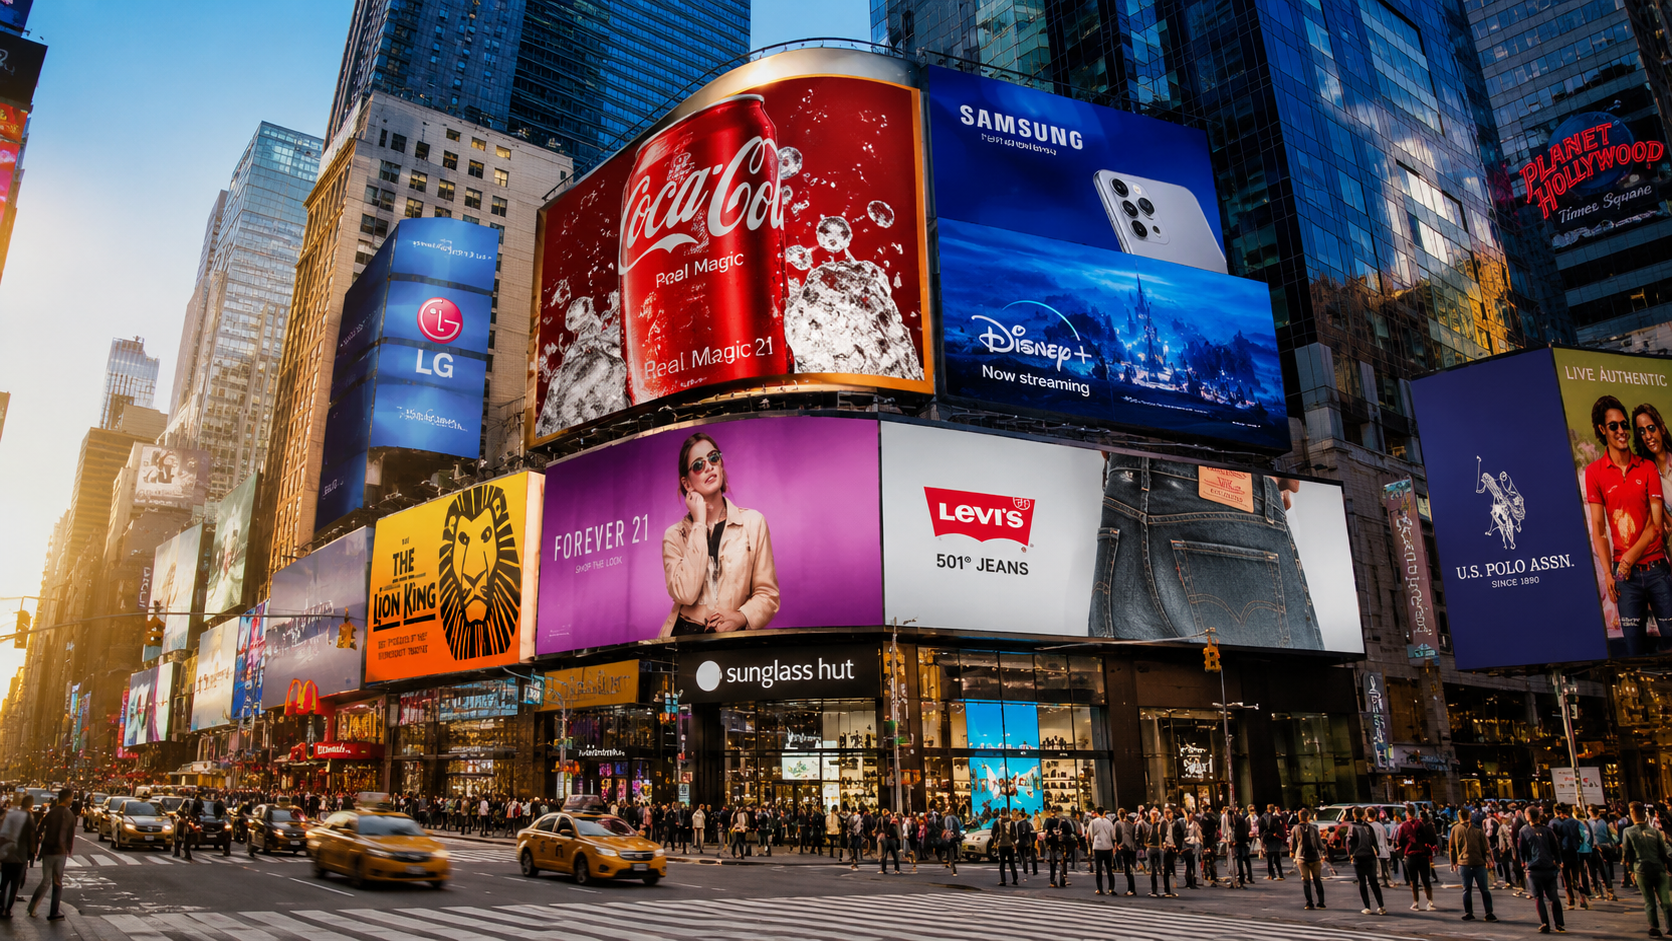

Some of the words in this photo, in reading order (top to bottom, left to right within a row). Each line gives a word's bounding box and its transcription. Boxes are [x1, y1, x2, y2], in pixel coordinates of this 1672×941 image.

[959, 104, 1084, 150] SAMSUNG
[1519, 122, 1612, 204] PLANET
[1533, 140, 1664, 220] HOLLYWOOD
[694, 251, 744, 276] Magic
[692, 340, 752, 369] Magic
[755, 336, 774, 357] 21
[971, 314, 1092, 372] Disney+
[415, 348, 454, 379] LG
[1564, 365, 1596, 382] LIVE
[1599, 365, 1668, 387] AUTHENTIC
[982, 364, 1015, 382] Now
[1019, 371, 1090, 397] streaming
[554, 520, 625, 562] FOREVER
[631, 513, 648, 544] 21
[392, 547, 415, 577] THE
[976, 557, 1029, 576] JEANS
[1456, 565, 1483, 580] U.S.
[1485, 559, 1526, 577] POLO
[1530, 553, 1575, 572] ASSN.
[1491, 578, 1518, 589] SINCE
[726, 658, 813, 688] sunglass
[817, 657, 855, 681] hut
